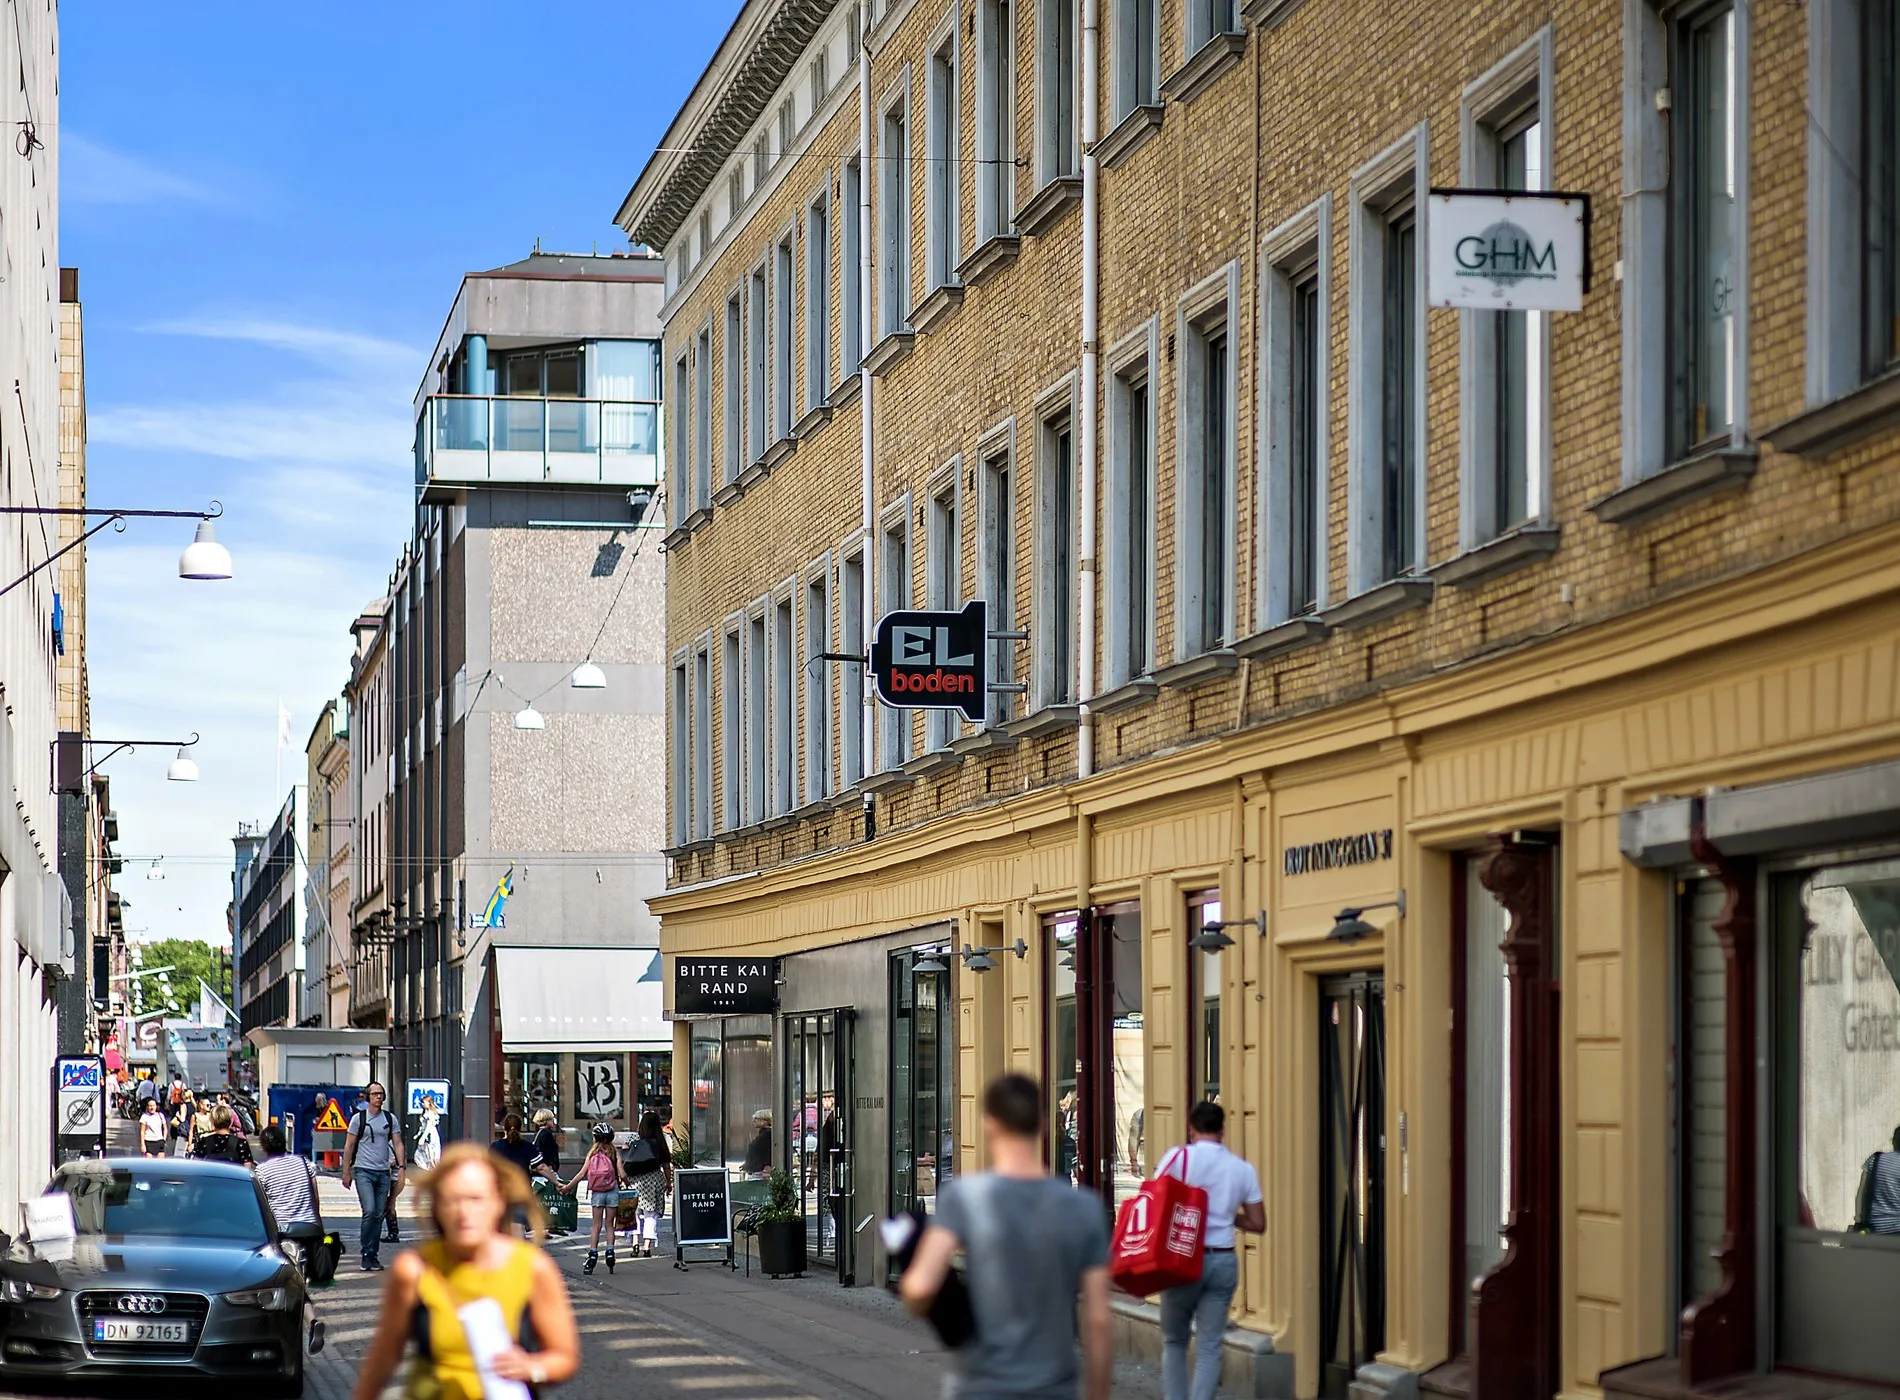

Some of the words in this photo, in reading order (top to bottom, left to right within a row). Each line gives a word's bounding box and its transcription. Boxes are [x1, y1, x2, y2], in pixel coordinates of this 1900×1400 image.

[1455, 235, 1557, 272] GHM
[891, 625, 975, 667] EL
[891, 667, 975, 693] boden
[680, 965, 729, 977] BITTE
[737, 965, 768, 977] KAI
[700, 983, 749, 994] RAND
[682, 1193, 706, 1201] BITTE
[107, 1324, 128, 1339] DN
[136, 1325, 182, 1341] 92165
